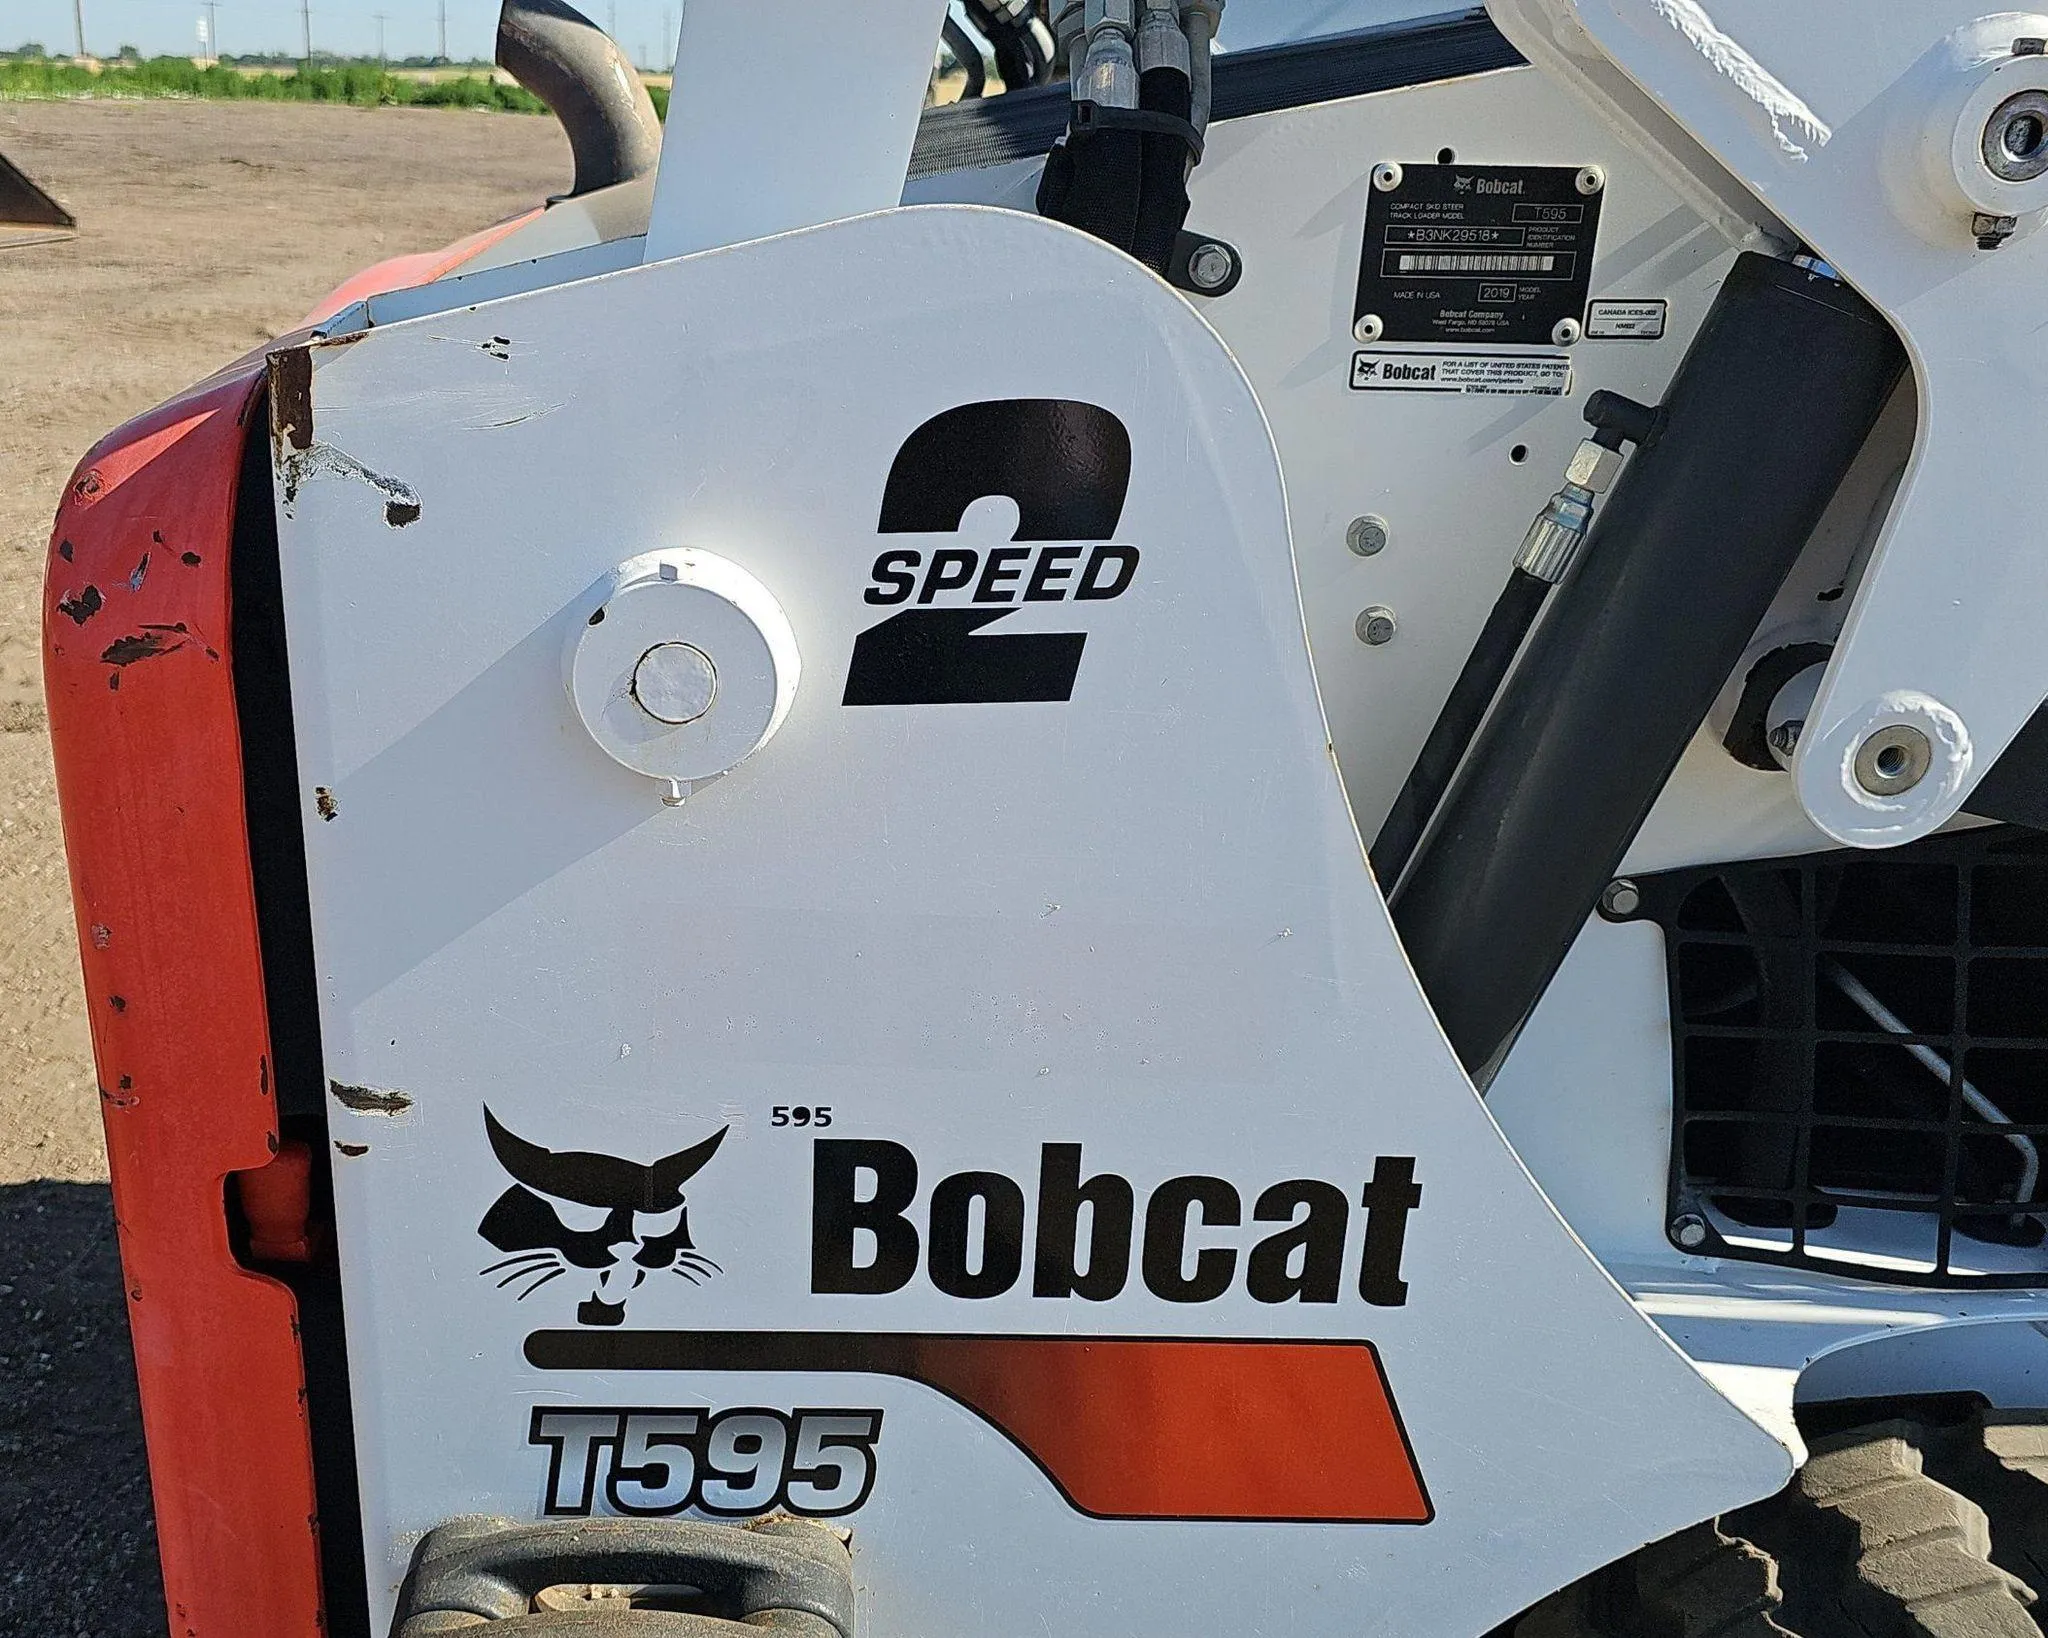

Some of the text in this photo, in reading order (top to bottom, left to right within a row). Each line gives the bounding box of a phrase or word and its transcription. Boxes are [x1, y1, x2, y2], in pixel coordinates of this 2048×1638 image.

[1476, 178, 1523, 195] Bobcat
[1534, 206, 1567, 220] T595
[1393, 291, 1414, 299] MADE
[1483, 287, 1510, 299] 2019
[1440, 309, 1504, 320] Bobcat Company
[1382, 363, 1437, 381] Bobcat
[841, 398, 1133, 707] 2
[862, 544, 1141, 606] SPEED
[771, 1105, 833, 1128] 595
[810, 1138, 1424, 1307] Bobcat
[528, 1405, 884, 1519] T595
